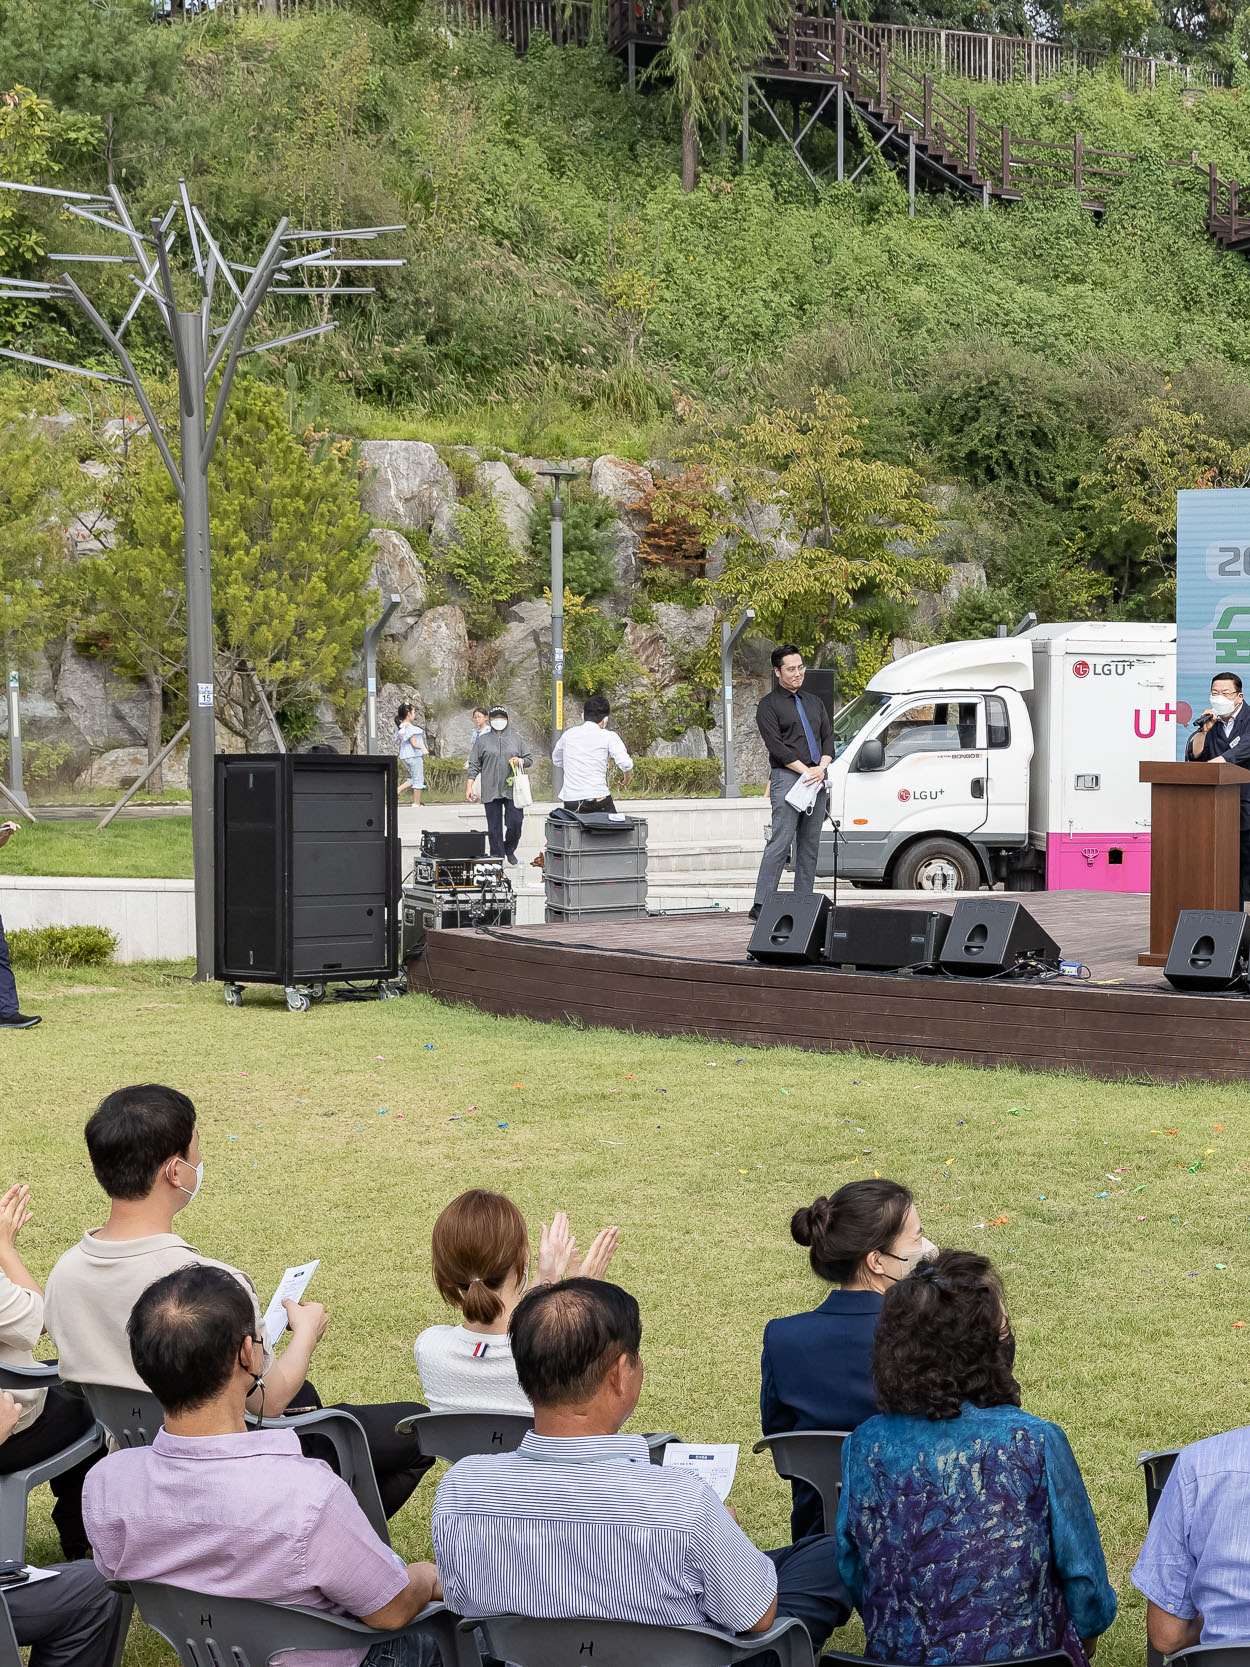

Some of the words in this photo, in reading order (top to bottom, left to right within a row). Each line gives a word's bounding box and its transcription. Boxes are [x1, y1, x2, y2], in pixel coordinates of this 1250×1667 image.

[1093, 663, 1112, 676] LG
[202, 694, 212, 702] 15
[1134, 703, 1177, 738] U+
[913, 791, 928, 801] LG
[131, 1407, 142, 1420] H
[491, 1431, 503, 1446] H
[200, 1613, 213, 1630] H
[579, 1640, 594, 1657] H
